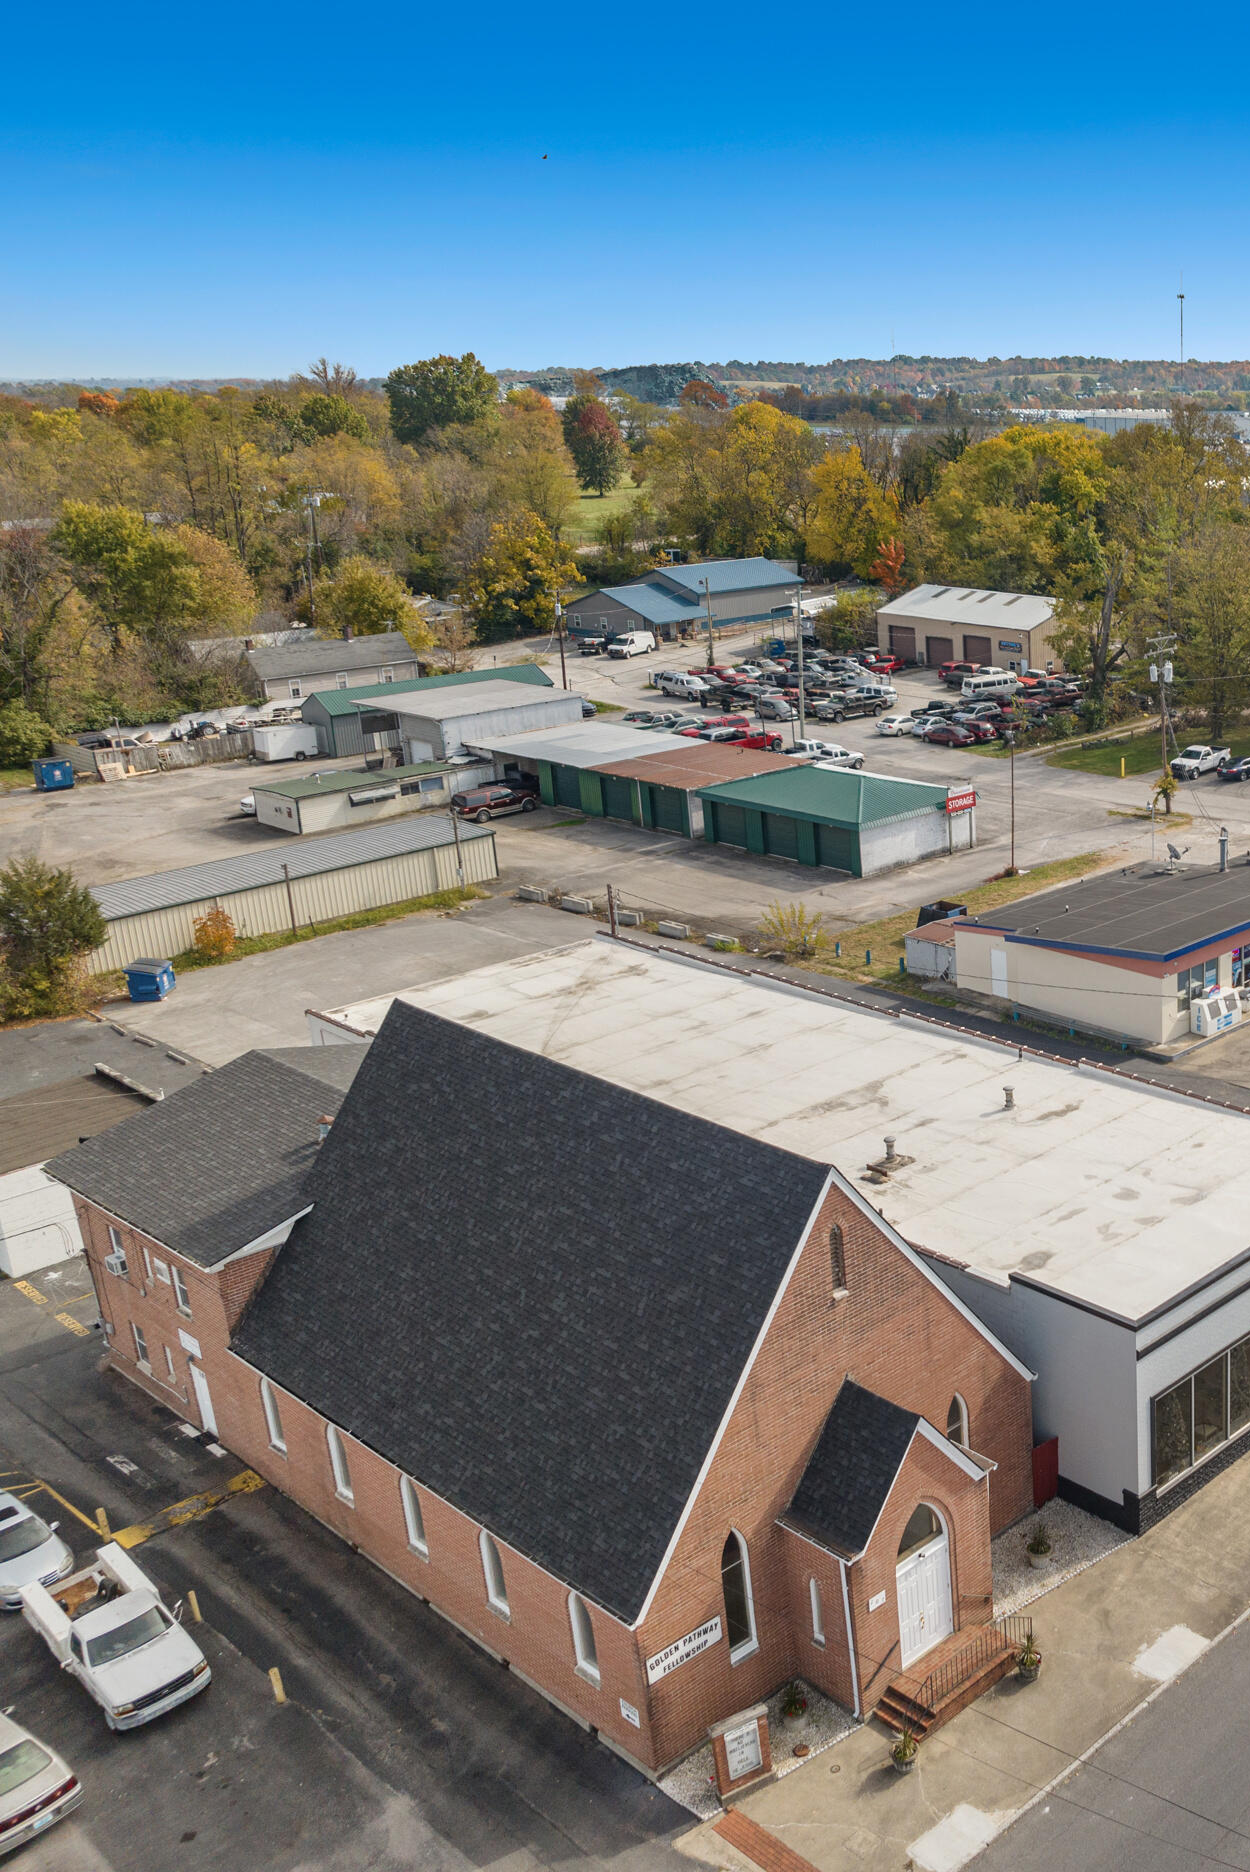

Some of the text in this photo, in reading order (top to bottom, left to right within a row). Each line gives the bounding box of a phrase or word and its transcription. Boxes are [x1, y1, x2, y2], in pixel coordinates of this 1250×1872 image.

[948, 795, 974, 809] STORAGE
[13, 1280, 48, 1305] RESERVED
[55, 1312, 91, 1336] RESERVED
[649, 1621, 719, 1671] GOLDEN PATHWAY
[663, 1639, 709, 1674] FELLOWSHIP
